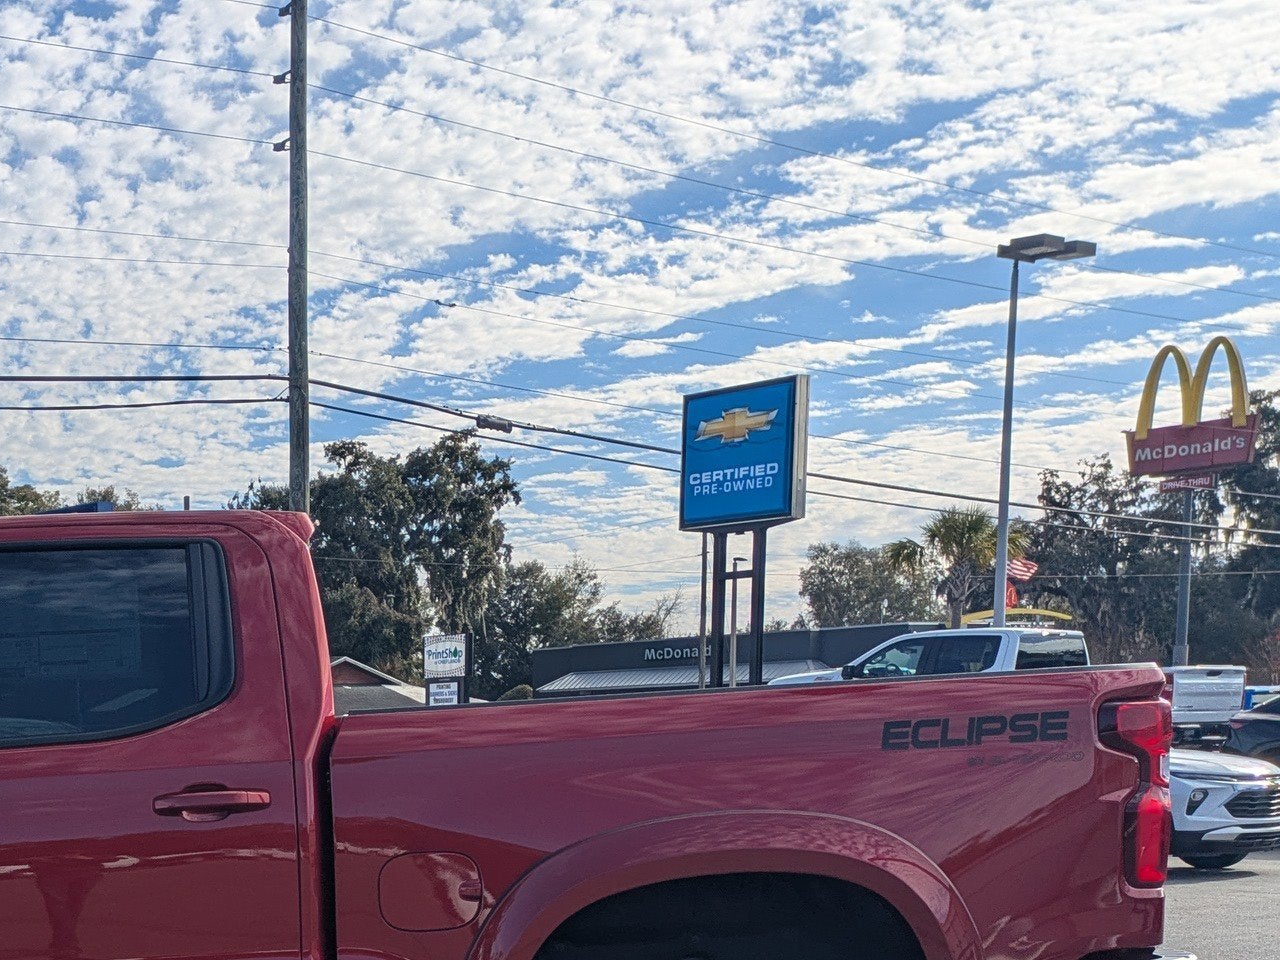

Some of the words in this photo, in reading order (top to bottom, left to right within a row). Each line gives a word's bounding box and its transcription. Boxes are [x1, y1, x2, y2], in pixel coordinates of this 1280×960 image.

[1134, 436, 1246, 462] McDonald's
[689, 462, 779, 486] CERTIFIED
[693, 477, 773, 497] PRE-OWNED
[644, 645, 712, 660] McDonad
[881, 711, 1070, 750] ECLIPSE
